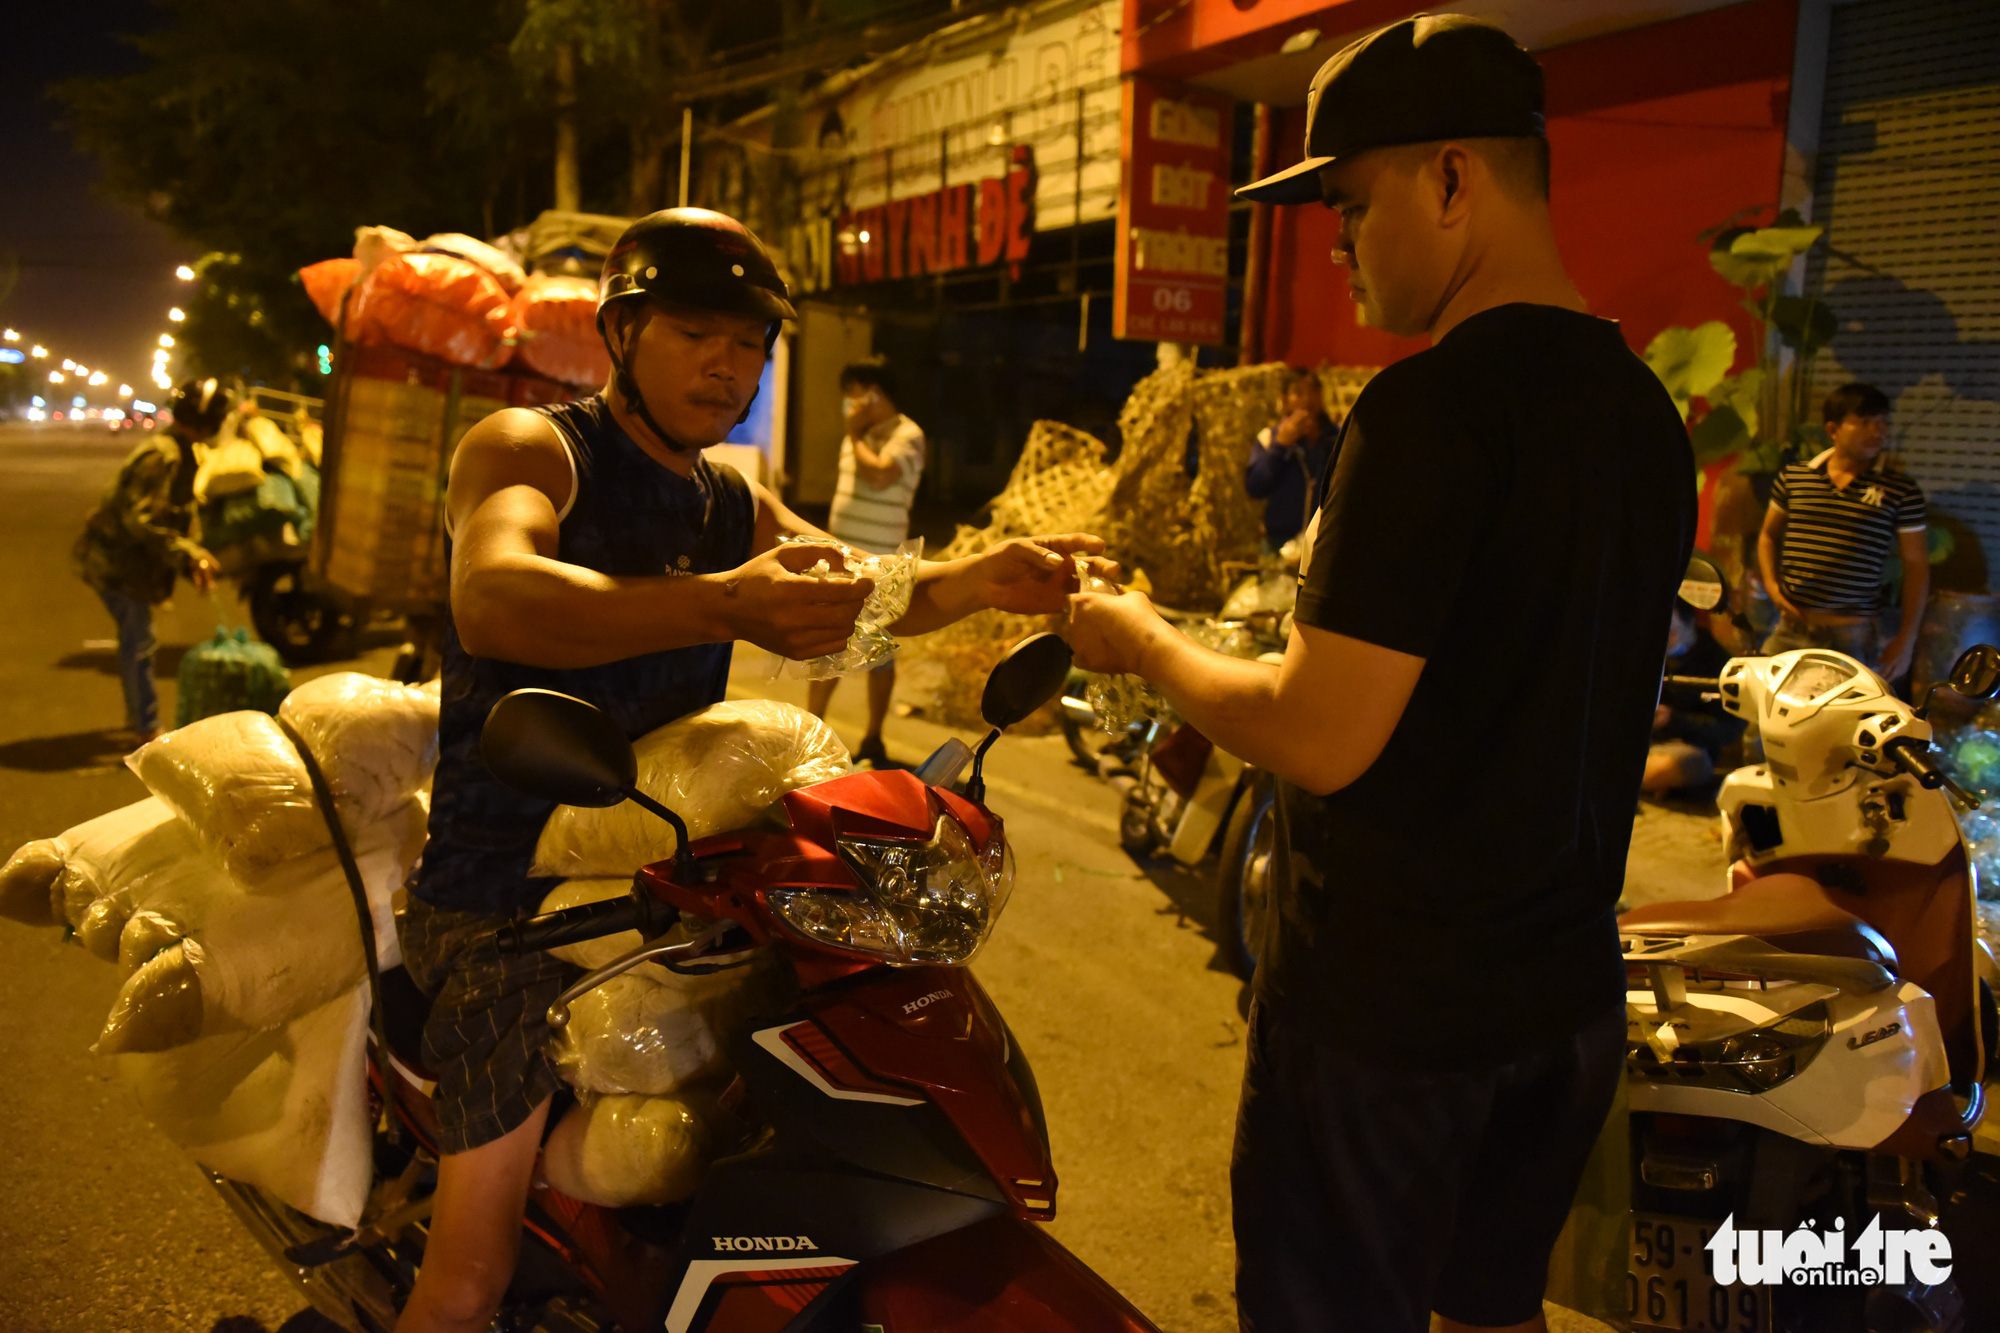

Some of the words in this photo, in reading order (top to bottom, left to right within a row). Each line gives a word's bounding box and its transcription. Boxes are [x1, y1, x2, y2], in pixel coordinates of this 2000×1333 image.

[1153, 287, 1192, 313] 06
[902, 989, 954, 1015] HONDA
[1846, 1022, 1902, 1051] LEAD
[711, 1235, 819, 1252] HONDA
